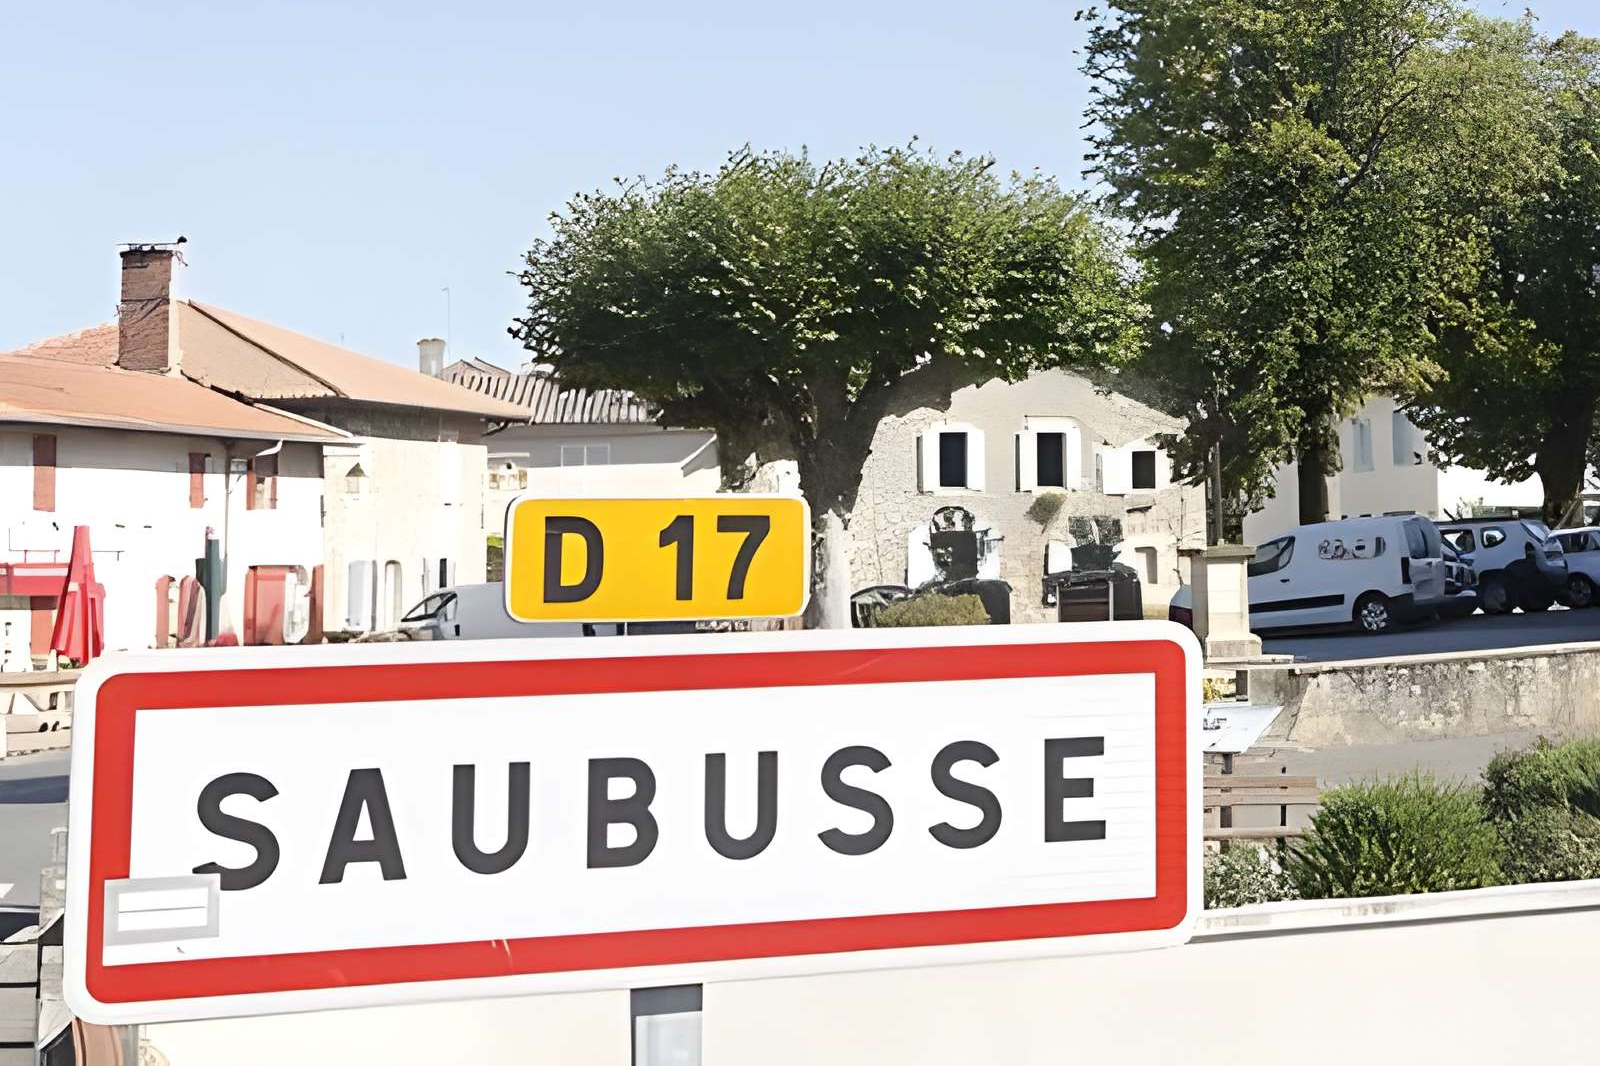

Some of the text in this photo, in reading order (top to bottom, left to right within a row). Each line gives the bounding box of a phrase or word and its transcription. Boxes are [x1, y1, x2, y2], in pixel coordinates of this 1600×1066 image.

[543, 515, 771, 604] D 17
[191, 736, 1107, 891] SAUBUSSE
